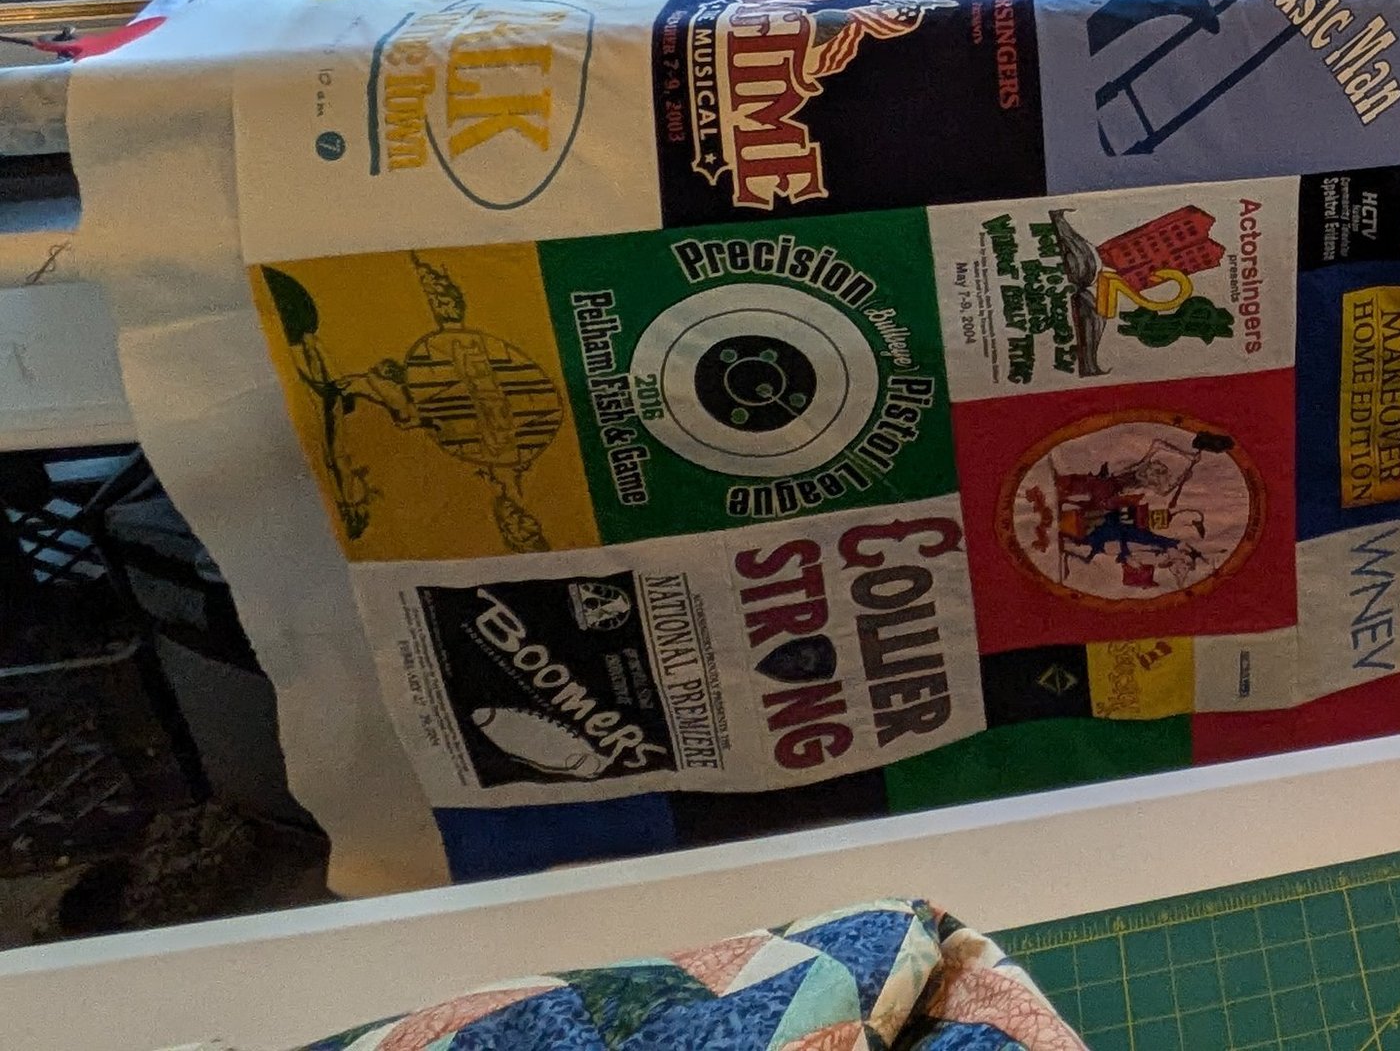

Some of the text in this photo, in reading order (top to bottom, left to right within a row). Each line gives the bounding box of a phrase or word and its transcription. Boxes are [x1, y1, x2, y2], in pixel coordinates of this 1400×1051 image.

[694, 29, 719, 141] MUSICAL
[1360, 190, 1378, 241] HCTV
[672, 235, 876, 309] Precision
[952, 262, 969, 289] May
[961, 315, 978, 346] 2004
[1227, 254, 1241, 304] presents
[1238, 197, 1264, 355] Actorsingers
[571, 290, 649, 507] Pelham Fish & Game
[633, 373, 666, 421] 2016
[869, 374, 935, 473] Pistol
[1349, 297, 1376, 503] HOME EDITION
[726, 455, 872, 519] League
[837, 514, 965, 750] COLLIER
[1347, 527, 1398, 671] WNEV
[644, 574, 720, 770] NATIONAL PREMIERE
